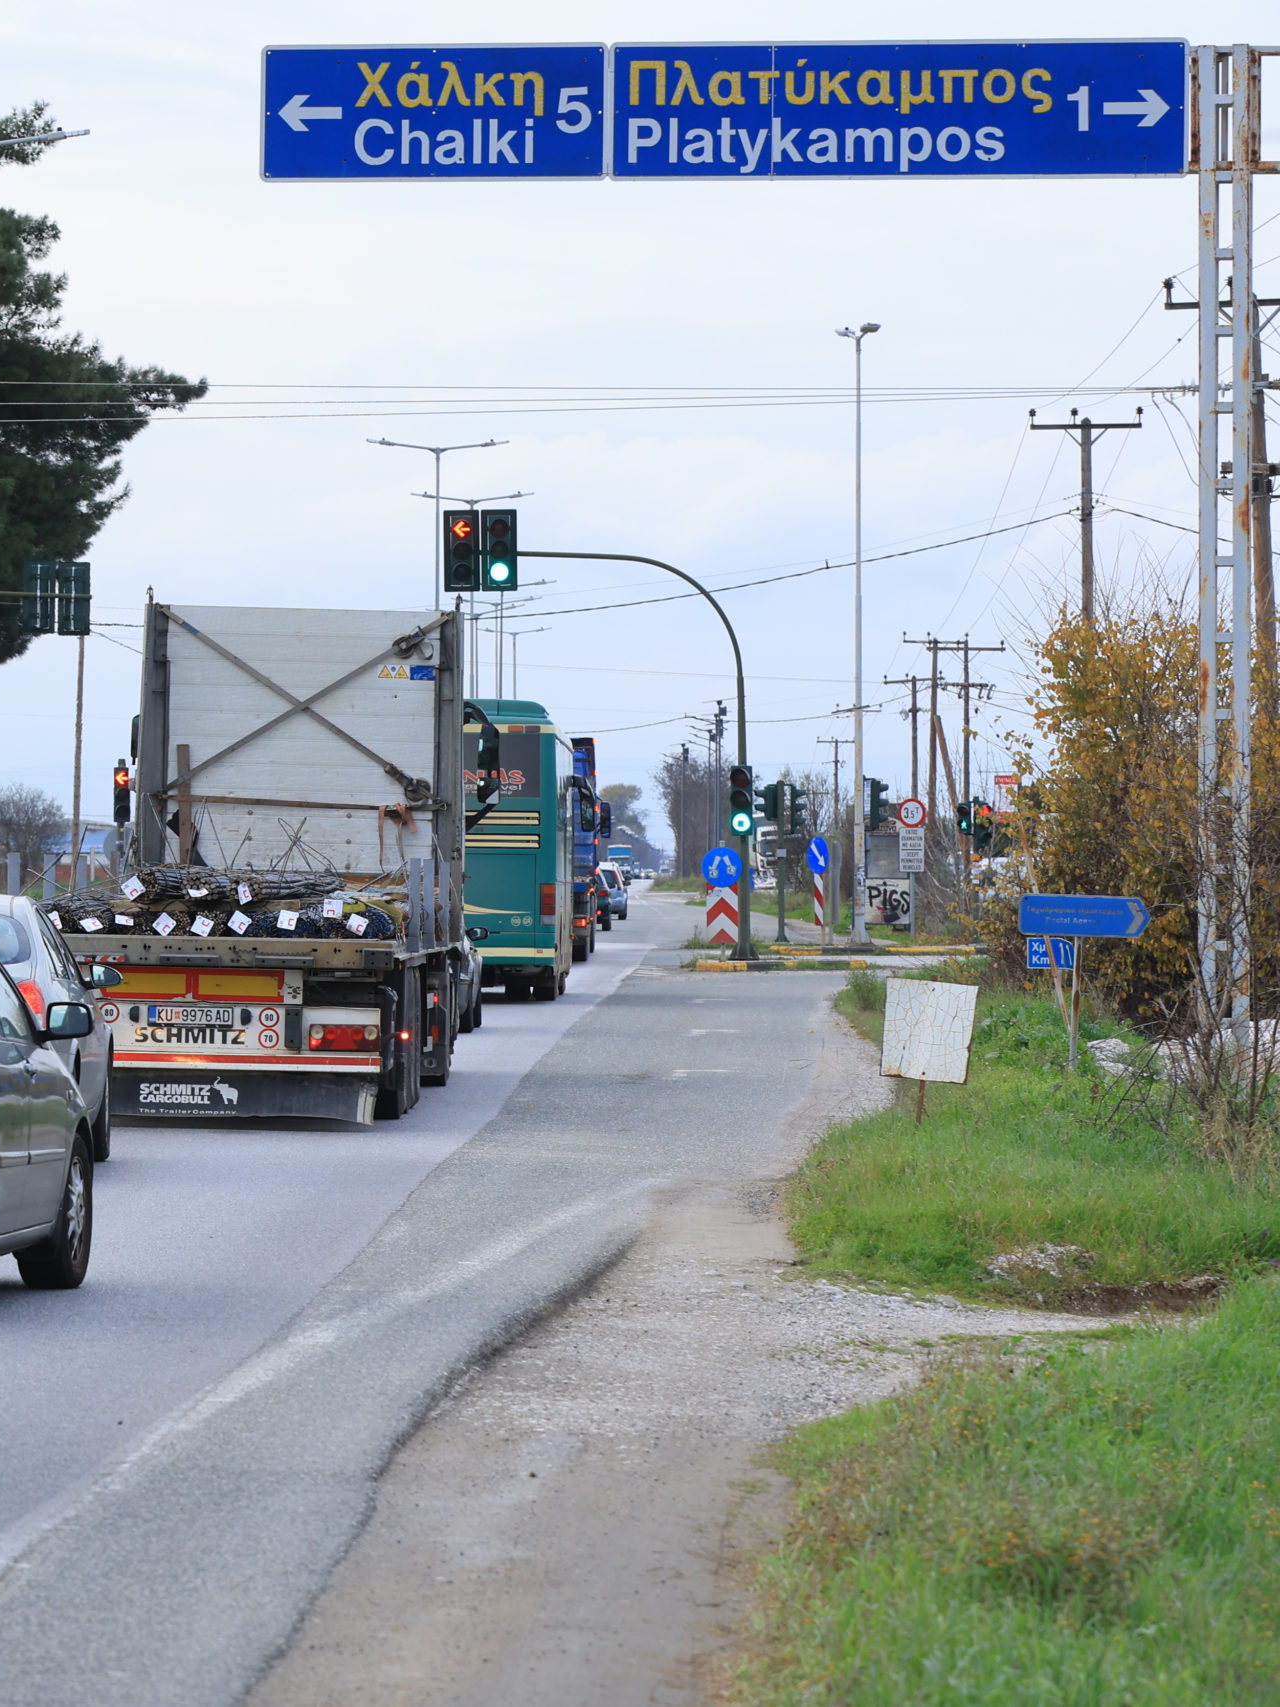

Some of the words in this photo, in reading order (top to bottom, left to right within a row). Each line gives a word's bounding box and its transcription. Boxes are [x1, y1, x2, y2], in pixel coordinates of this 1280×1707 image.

[354, 60, 545, 117] Χάλκη
[629, 58, 1053, 115] Πλατύκαμπος
[555, 86, 592, 134] 5
[1066, 85, 1090, 132] 1
[353, 117, 534, 166] Chalki
[627, 117, 1006, 173] Platykampos
[104, 1008, 114, 1017] 80
[157, 1008, 174, 1021] KU
[181, 1008, 213, 1022] 9976
[215, 1010, 231, 1023] AD
[264, 1013, 274, 1022] 90
[134, 1027, 246, 1045] SCHMITZ
[263, 1034, 273, 1043] 70
[140, 1083, 211, 1096] SCHMITZ
[139, 1094, 210, 1105] CARGOBULL
